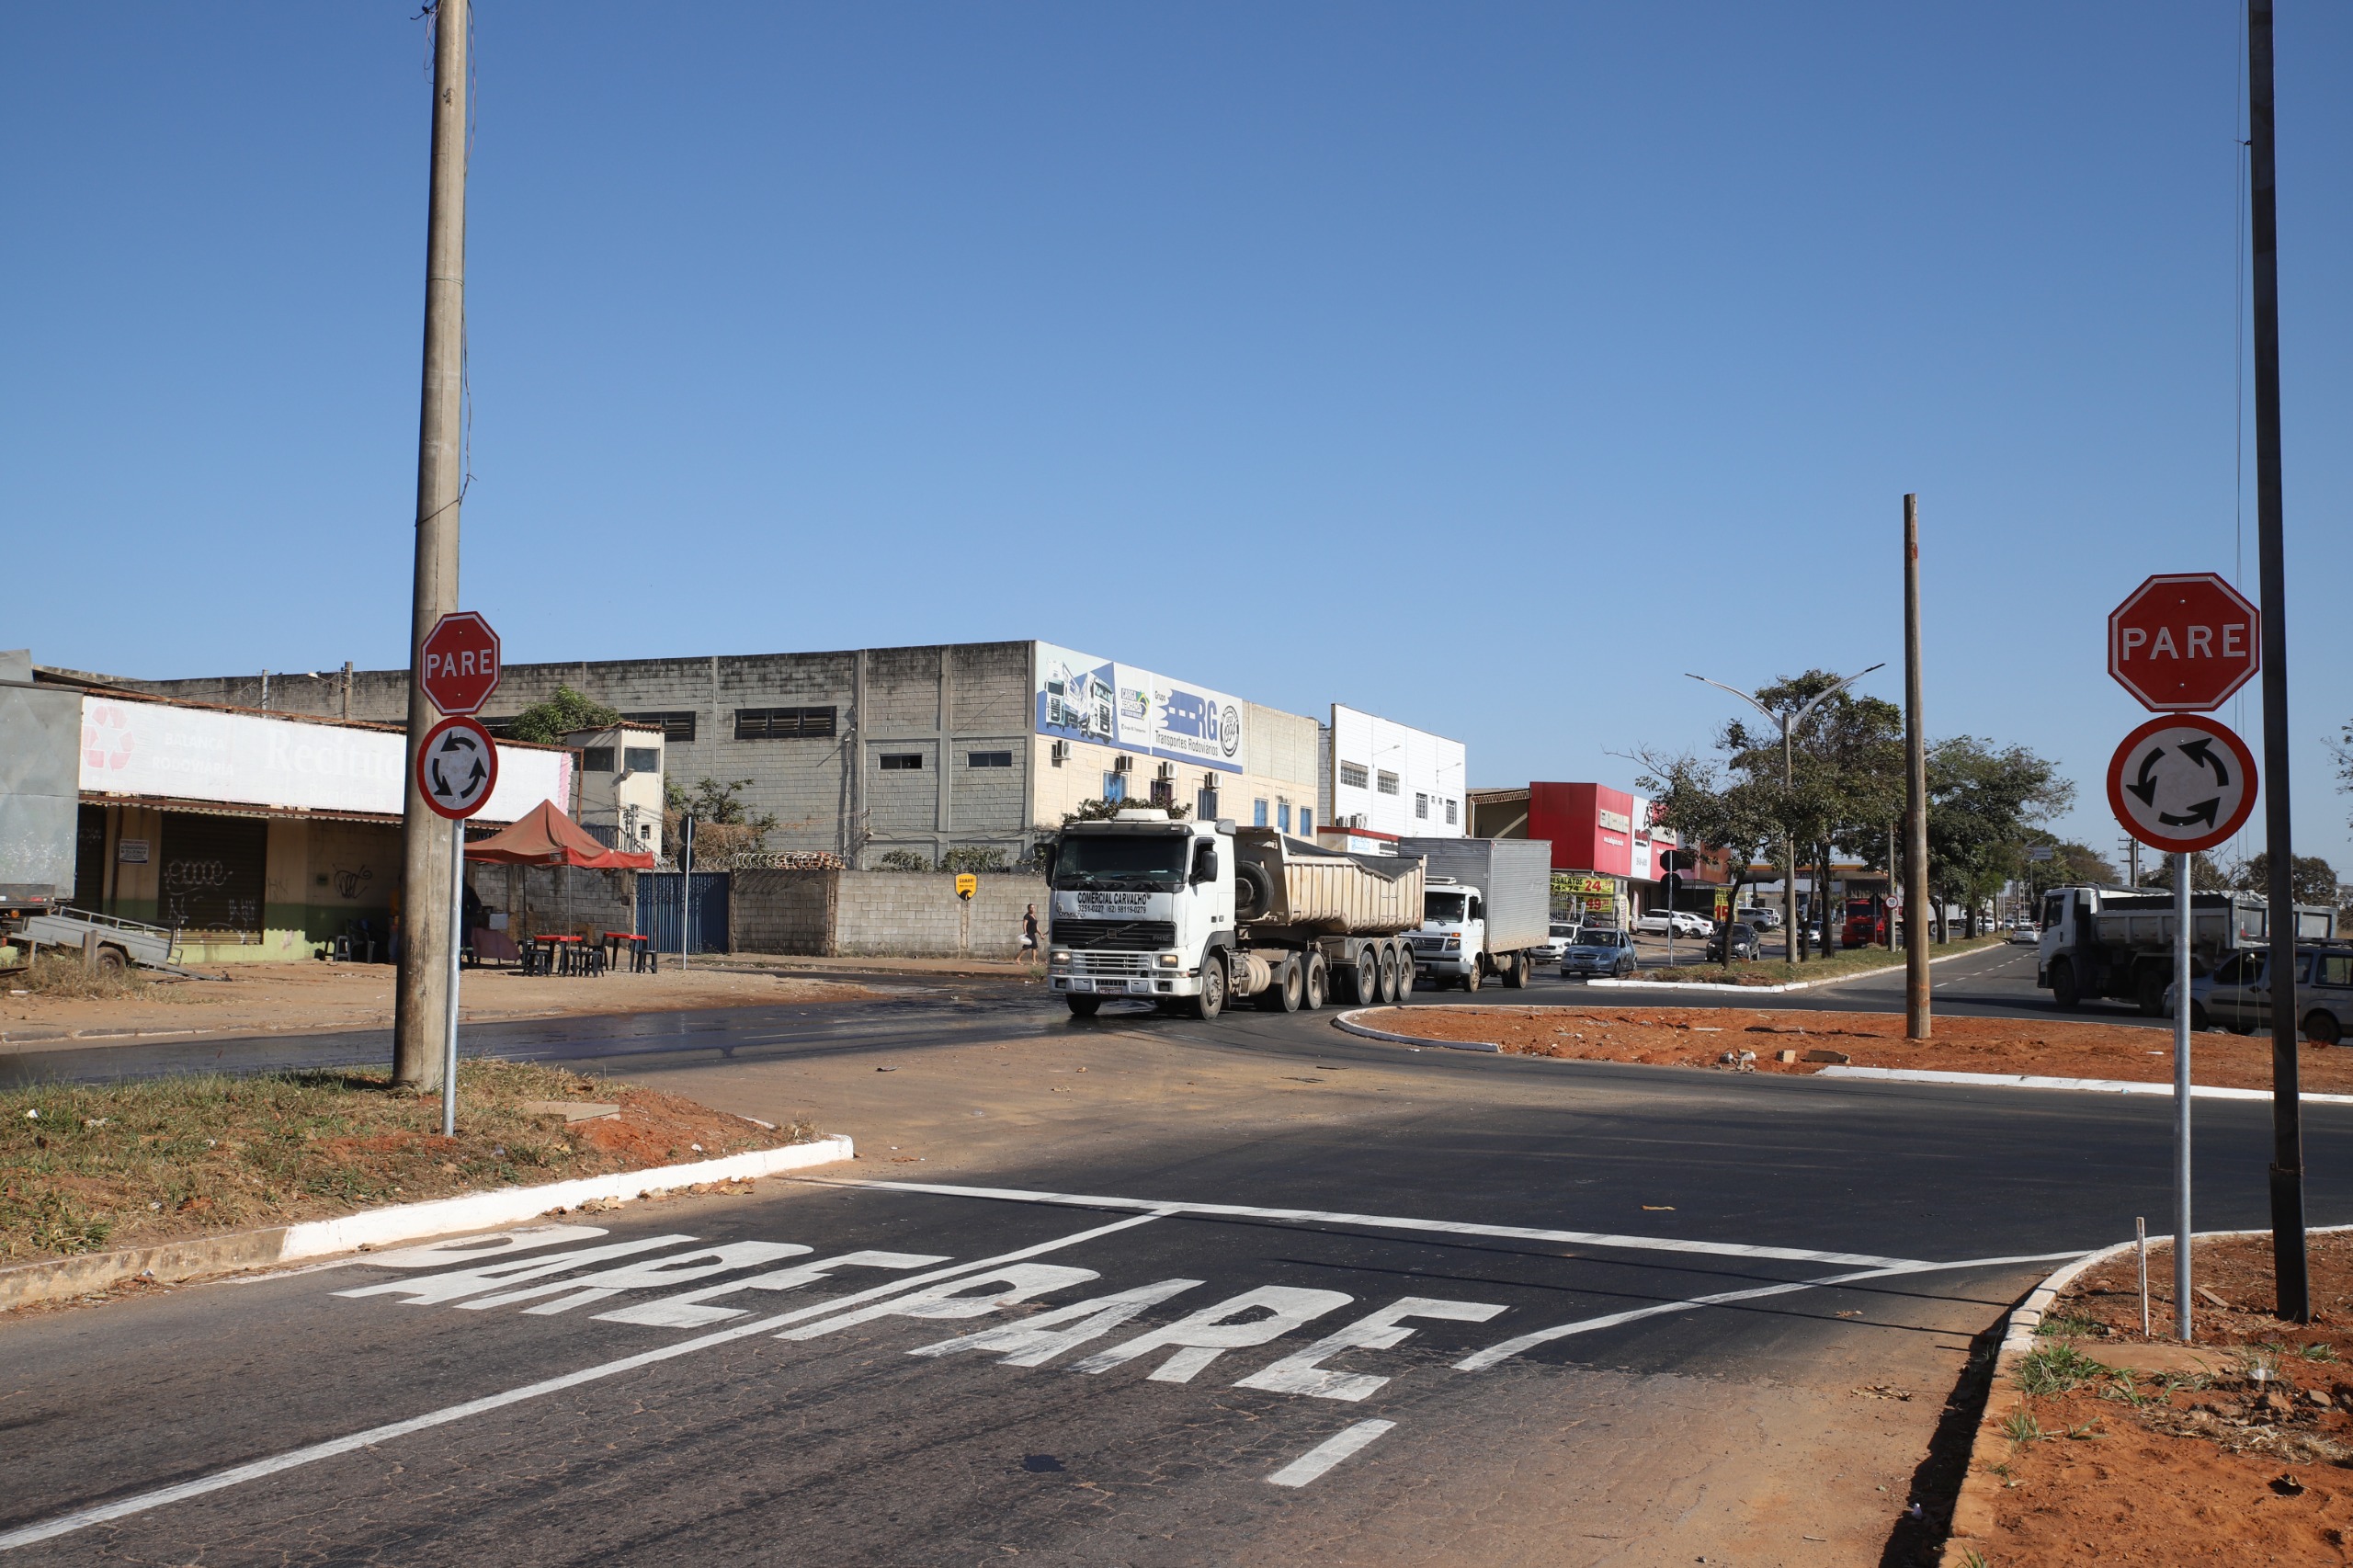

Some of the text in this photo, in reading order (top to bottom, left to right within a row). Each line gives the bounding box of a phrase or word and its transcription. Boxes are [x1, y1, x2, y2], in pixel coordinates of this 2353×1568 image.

[2122, 623, 2245, 660] PARE
[427, 649, 493, 678] PARE
[1154, 690, 1165, 701] Grupo
[1155, 730, 1219, 756] Transportes Rodoviários
[1077, 892, 1147, 905] COMERCIAL CARVALHO
[1077, 904, 1104, 913] 3251-0227
[1118, 905, 1147, 914] 98119-0279
[221, 1224, 955, 1328] PARE
[772, 1263, 1510, 1402] PARE
